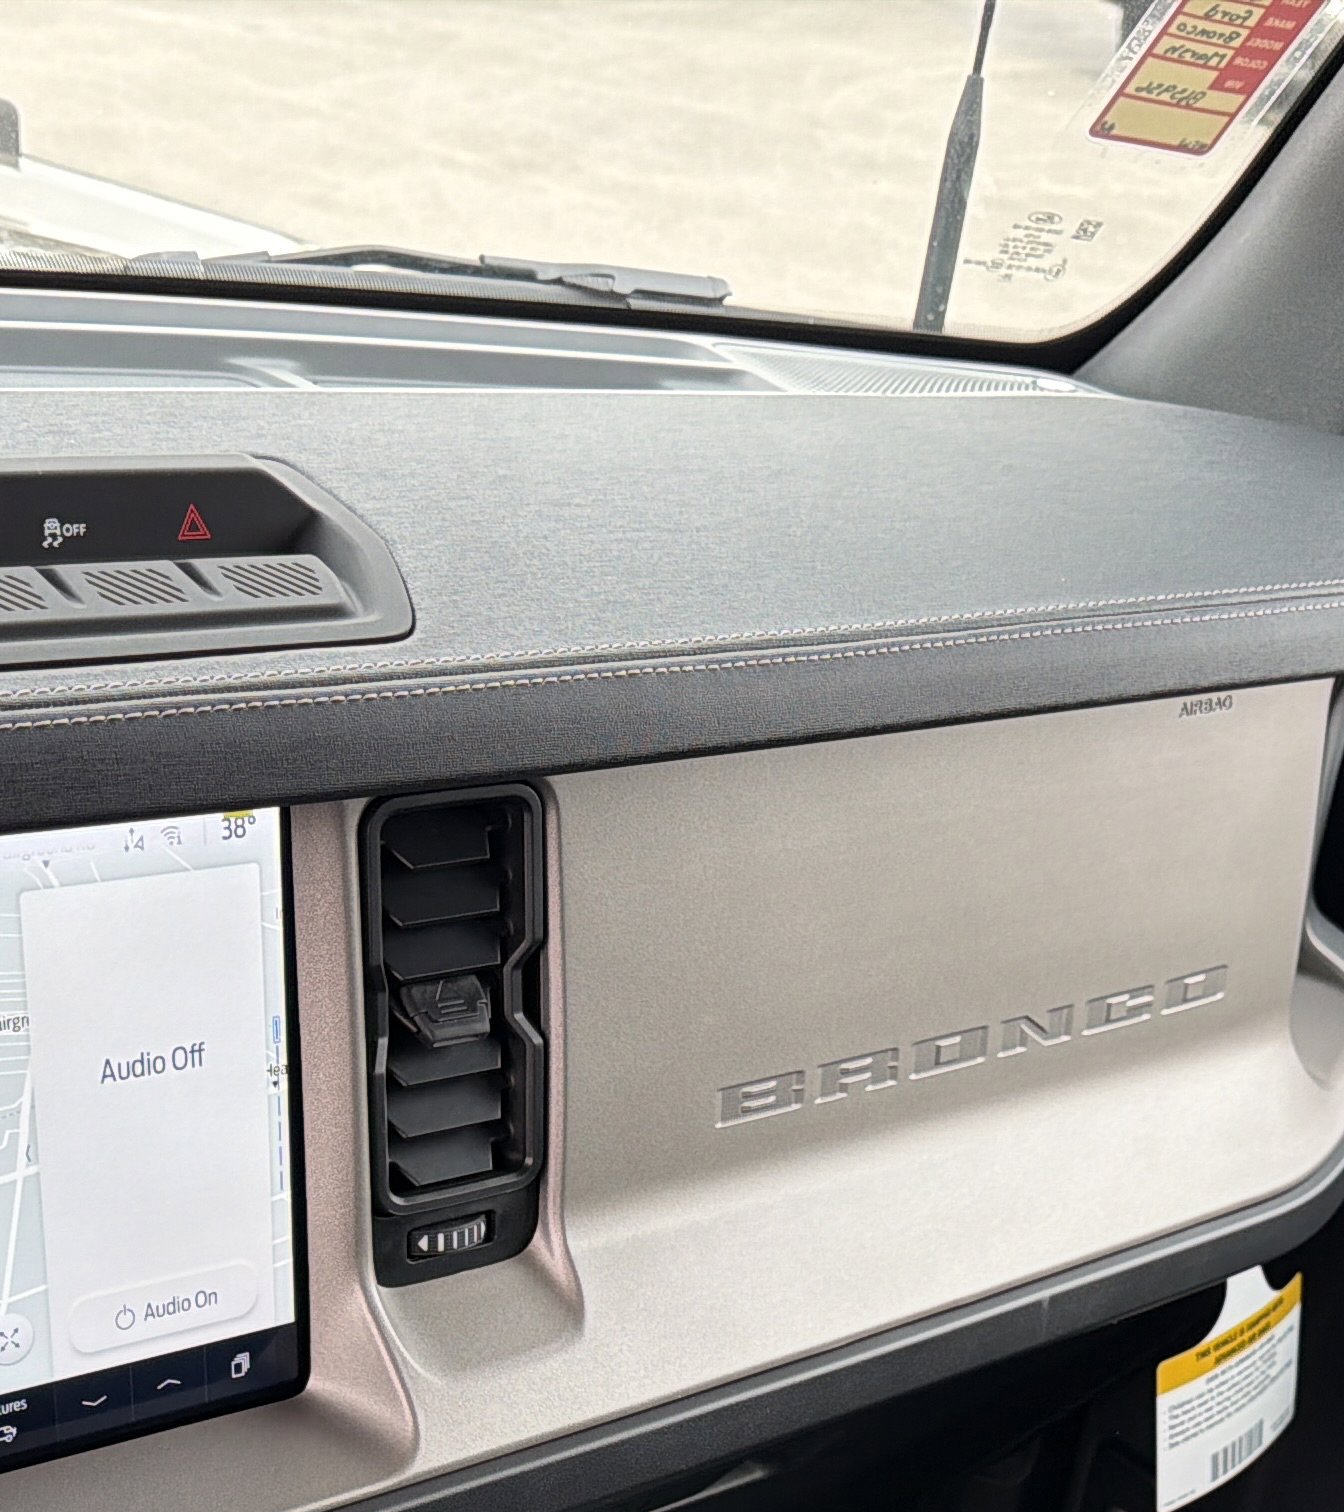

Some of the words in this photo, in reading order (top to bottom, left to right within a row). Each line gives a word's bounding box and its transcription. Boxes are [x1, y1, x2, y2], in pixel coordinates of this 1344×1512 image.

[62, 522, 87, 538] OFF
[1178, 694, 1234, 718] AIRBAG
[714, 963, 1229, 1128] BRONCO
[100, 1048, 166, 1086] Audio
[171, 1042, 207, 1072] Off
[144, 1293, 192, 1322] Audio
[194, 1288, 219, 1311] On
